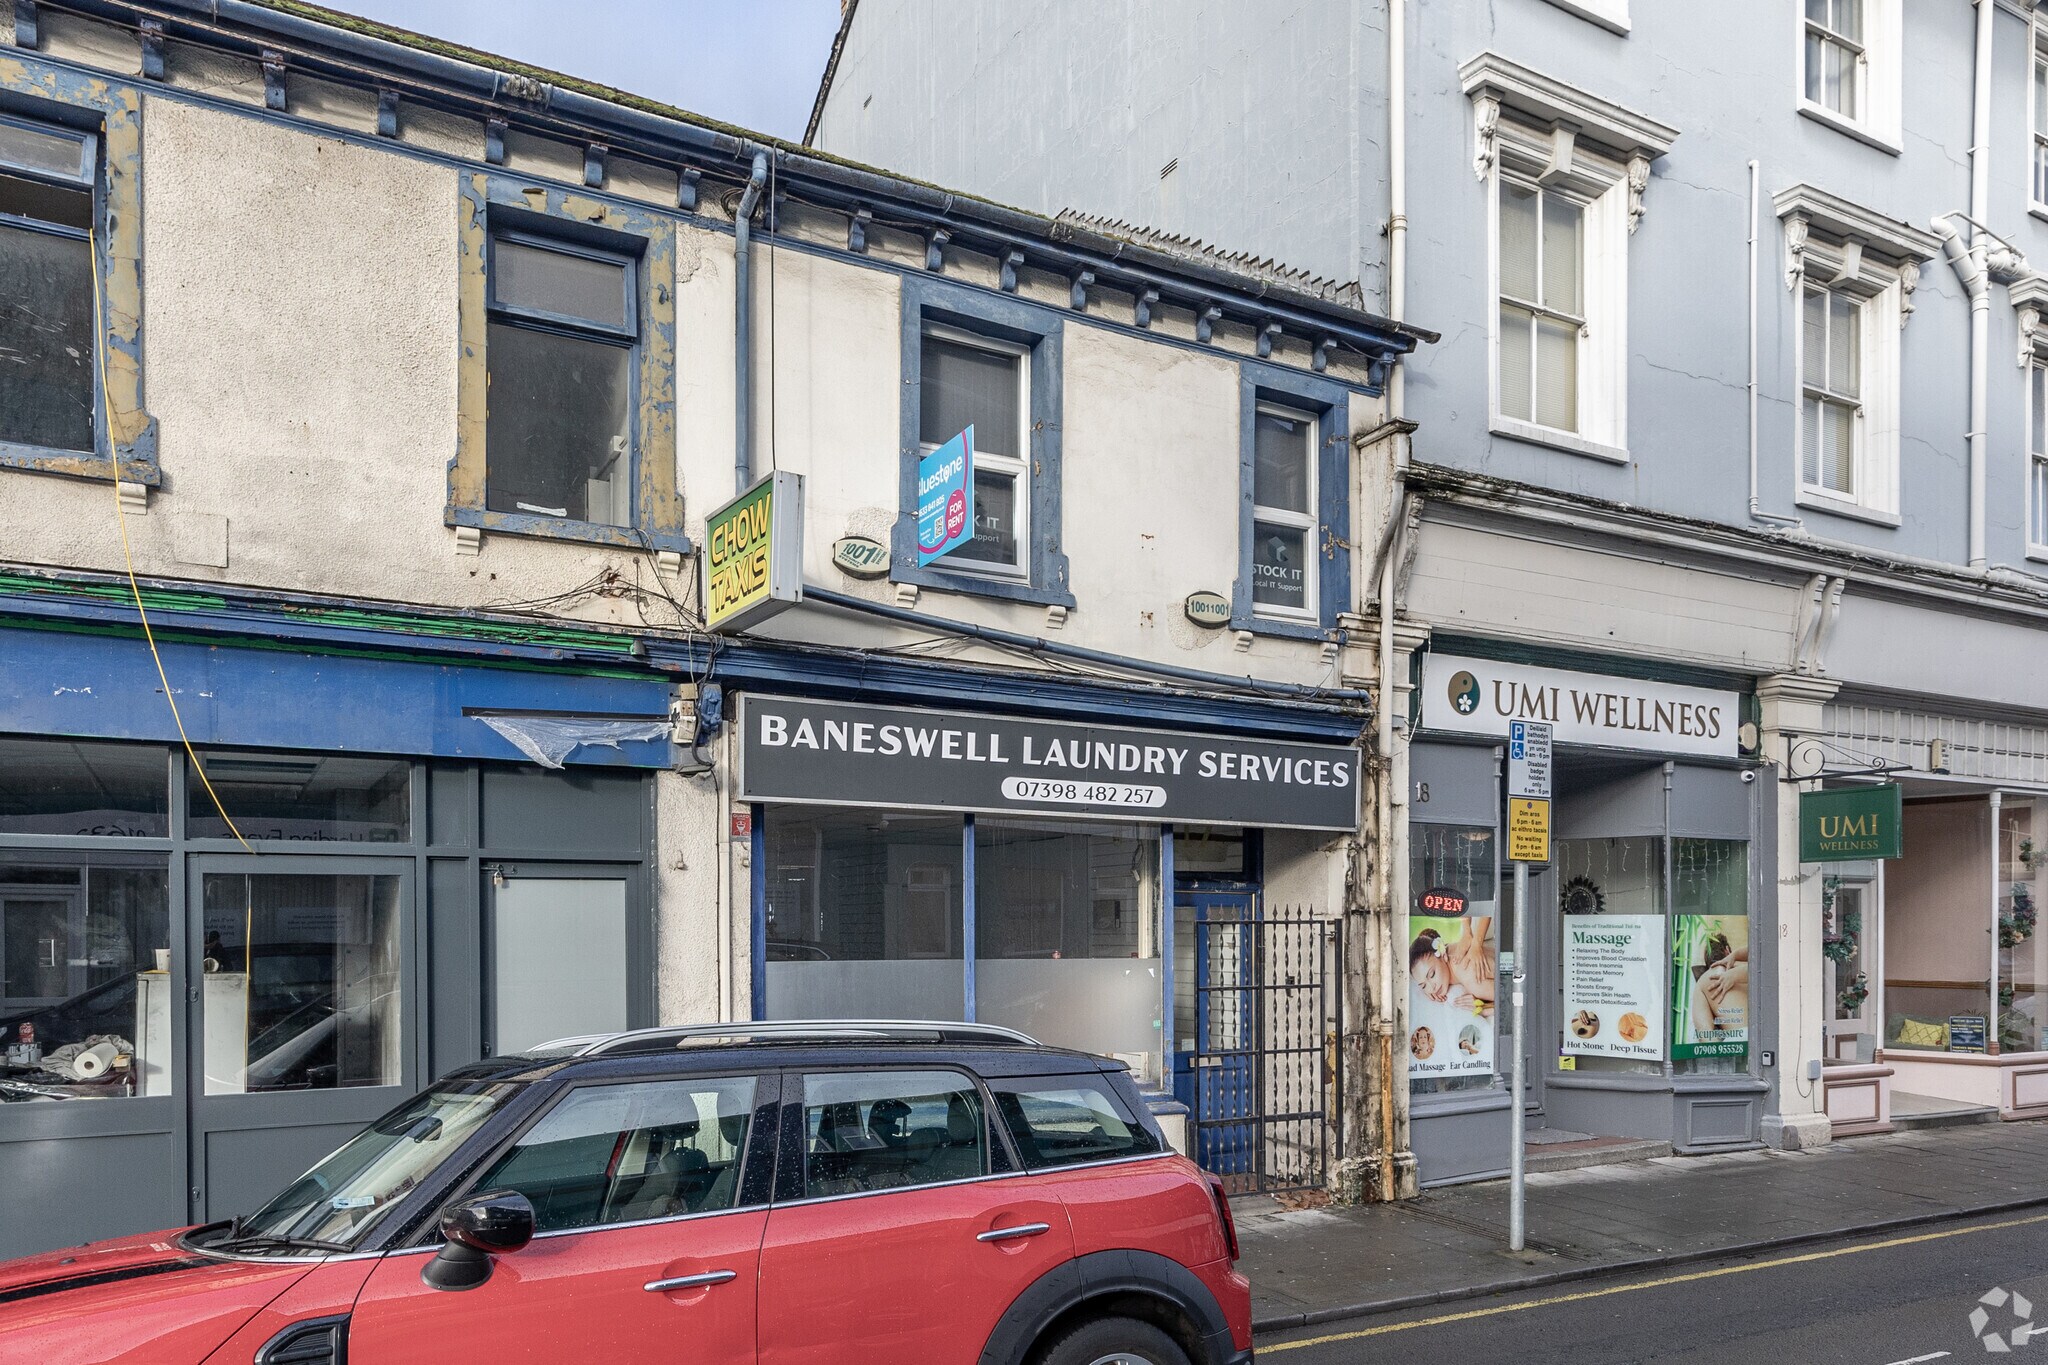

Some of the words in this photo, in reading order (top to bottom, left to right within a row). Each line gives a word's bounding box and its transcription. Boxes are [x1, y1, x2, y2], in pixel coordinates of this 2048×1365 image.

[919, 456, 963, 496] luestone
[949, 500, 963, 516] FOR
[947, 512, 964, 529] RENT
[986, 516, 1000, 529] IT
[711, 492, 772, 567] CHOW
[973, 533, 1000, 542] upport
[843, 542, 878, 565] 1001
[711, 544, 769, 613] TAXIS
[1291, 569, 1303, 580] IT
[1277, 582, 1303, 592] Support
[1492, 680, 1560, 721] UMI
[1570, 690, 1721, 739] WELLNESS
[760, 714, 1010, 763] BANESWELL
[1022, 736, 1189, 775] LAUNDRY
[1197, 750, 1350, 788] SERVICES
[1016, 780, 1077, 800] 07398
[1083, 785, 1117, 803] 482
[1123, 788, 1154, 804] 257
[1415, 781, 1430, 802] 18
[1819, 813, 1879, 838] UMI
[1819, 840, 1879, 851] WELLNESS
[1424, 895, 1463, 912] OPEN
[1572, 931, 1632, 947] Massage
[1693, 1029, 1744, 1041] Acupressure
[1567, 1041, 1581, 1049] Hot
[1582, 1042, 1605, 1050] Stone
[1610, 1043, 1631, 1053] Deep
[1633, 1045, 1657, 1054] Tissue
[1694, 1045, 1717, 1055] 07908
[1718, 1044, 1744, 1054] 955528
[1420, 1063, 1446, 1072] Massage
[1462, 1060, 1491, 1069] Candling
